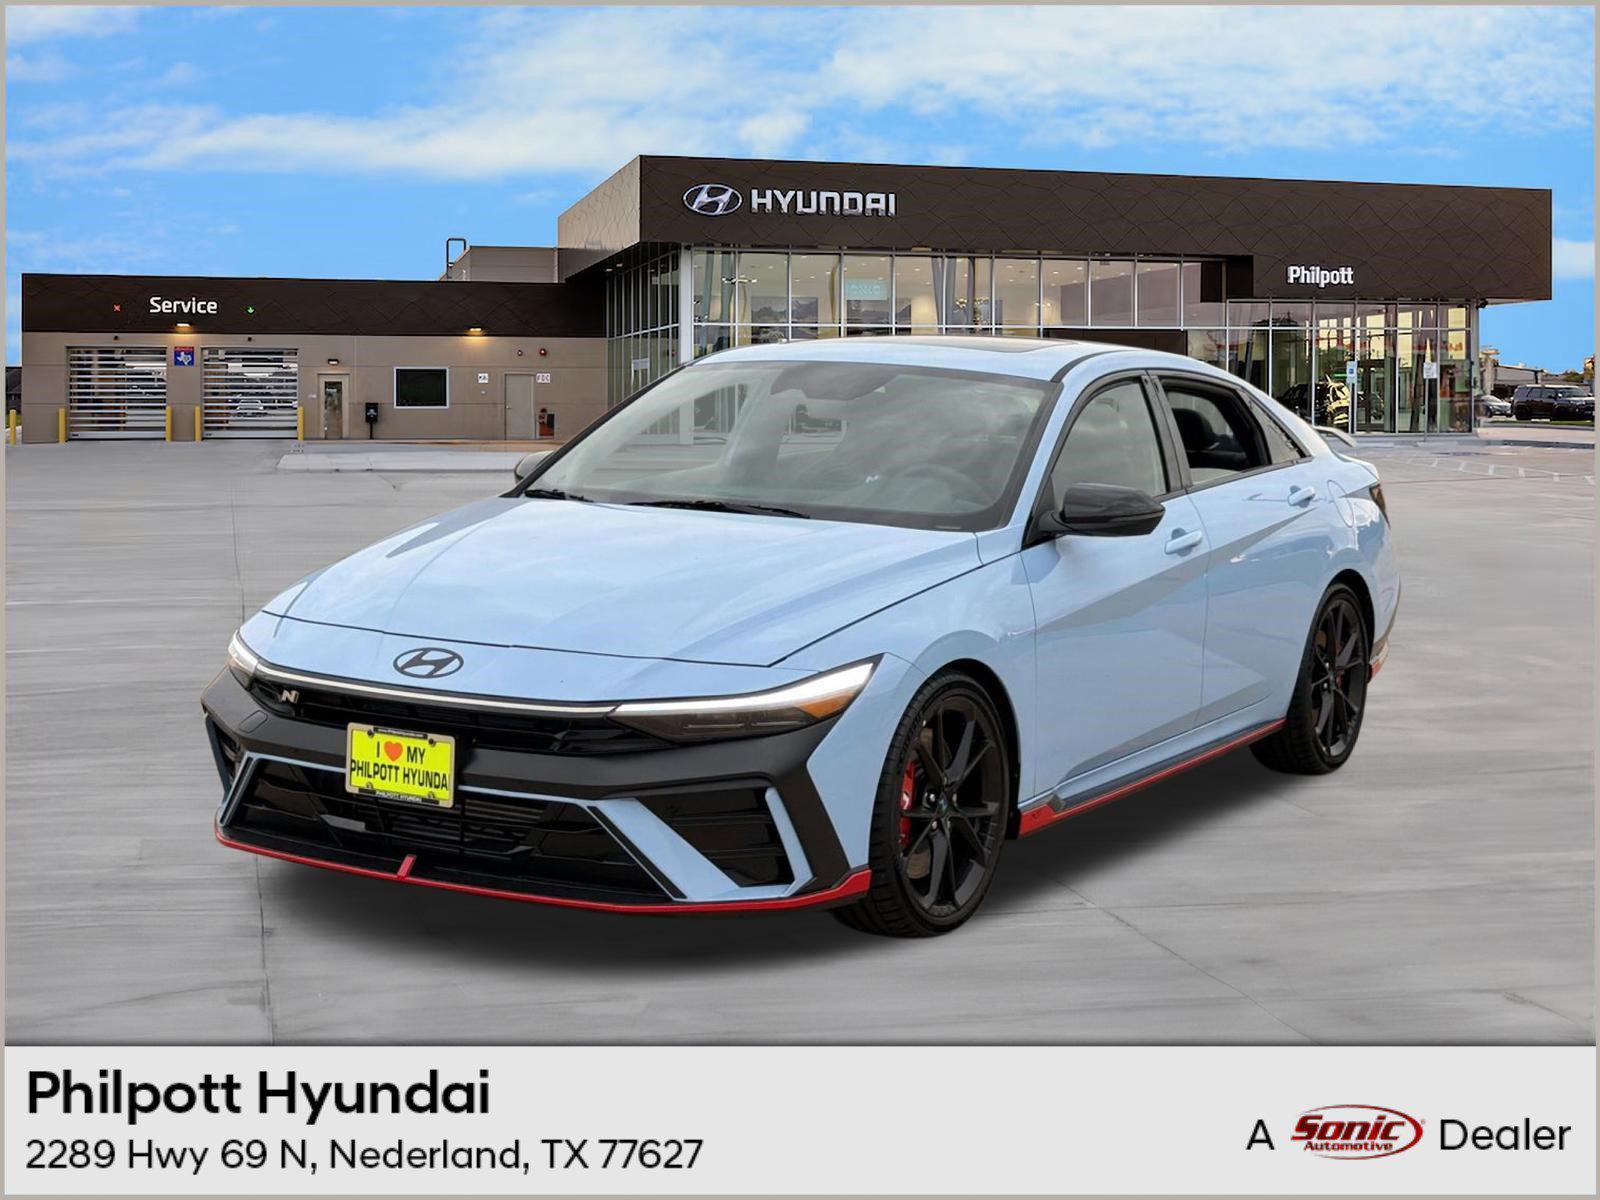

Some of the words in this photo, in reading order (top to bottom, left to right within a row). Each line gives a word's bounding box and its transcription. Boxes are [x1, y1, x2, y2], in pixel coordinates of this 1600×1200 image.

[751, 188, 896, 216] HYUNDAI
[1287, 265, 1354, 288] Philpott
[149, 296, 218, 314] Service
[375, 741, 380, 758] I
[406, 745, 426, 765] MY
[350, 759, 400, 783] PHILPOTT
[403, 766, 449, 791] HYUNDA
